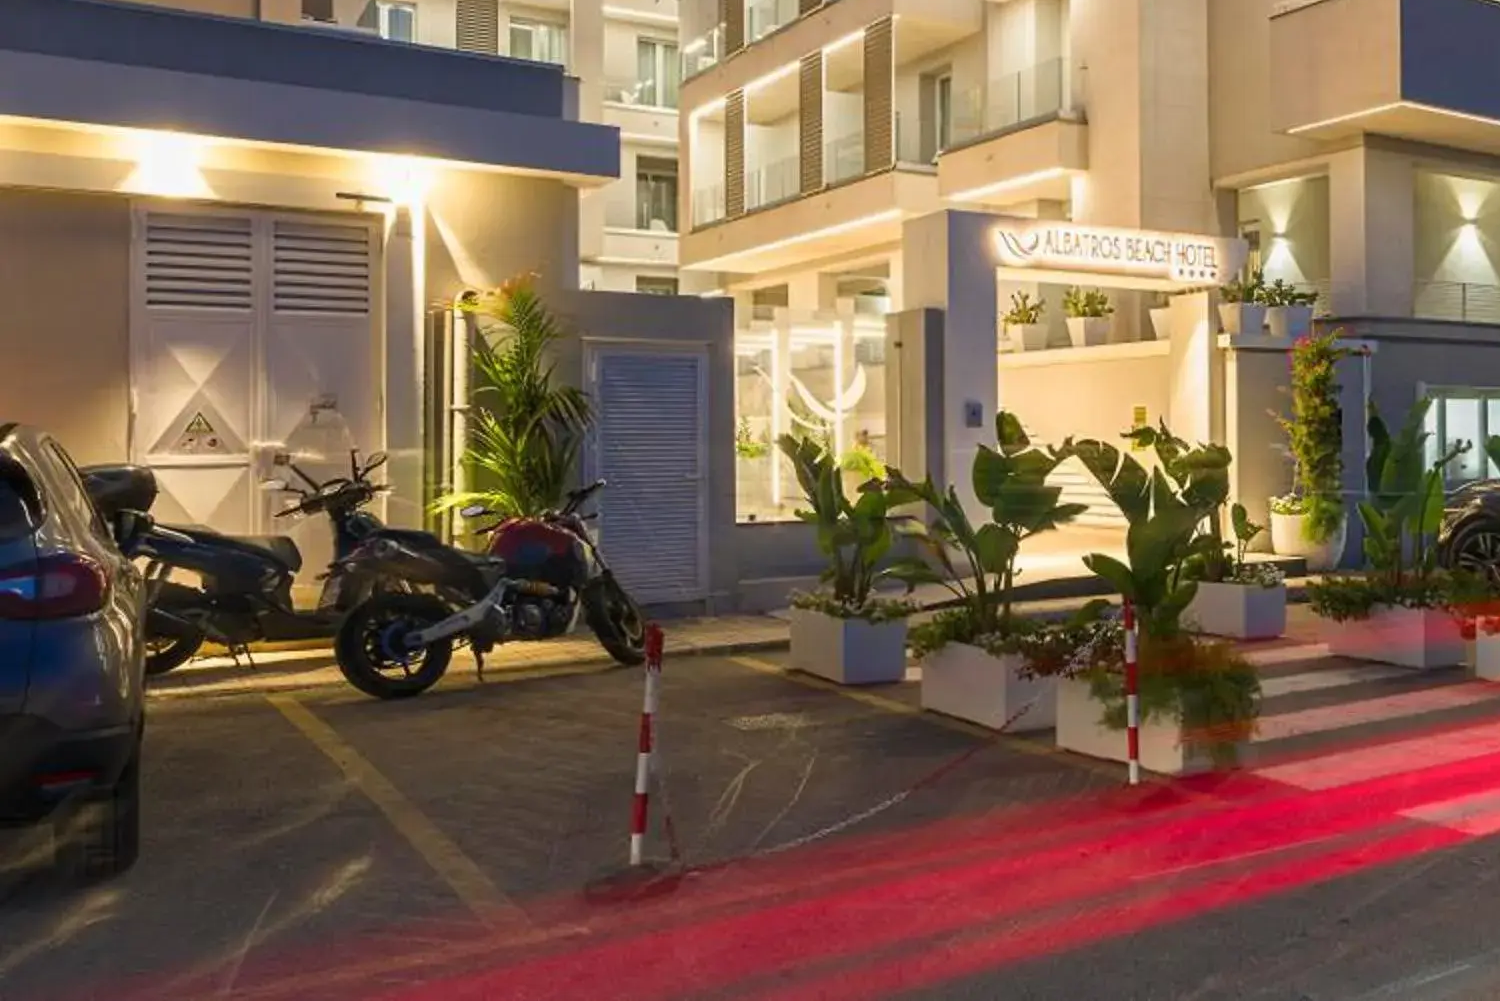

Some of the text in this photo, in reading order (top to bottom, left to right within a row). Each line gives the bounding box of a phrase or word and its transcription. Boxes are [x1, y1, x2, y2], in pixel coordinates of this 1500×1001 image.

[1043, 230, 1218, 268] ALBATROS BEACH HOTEL
